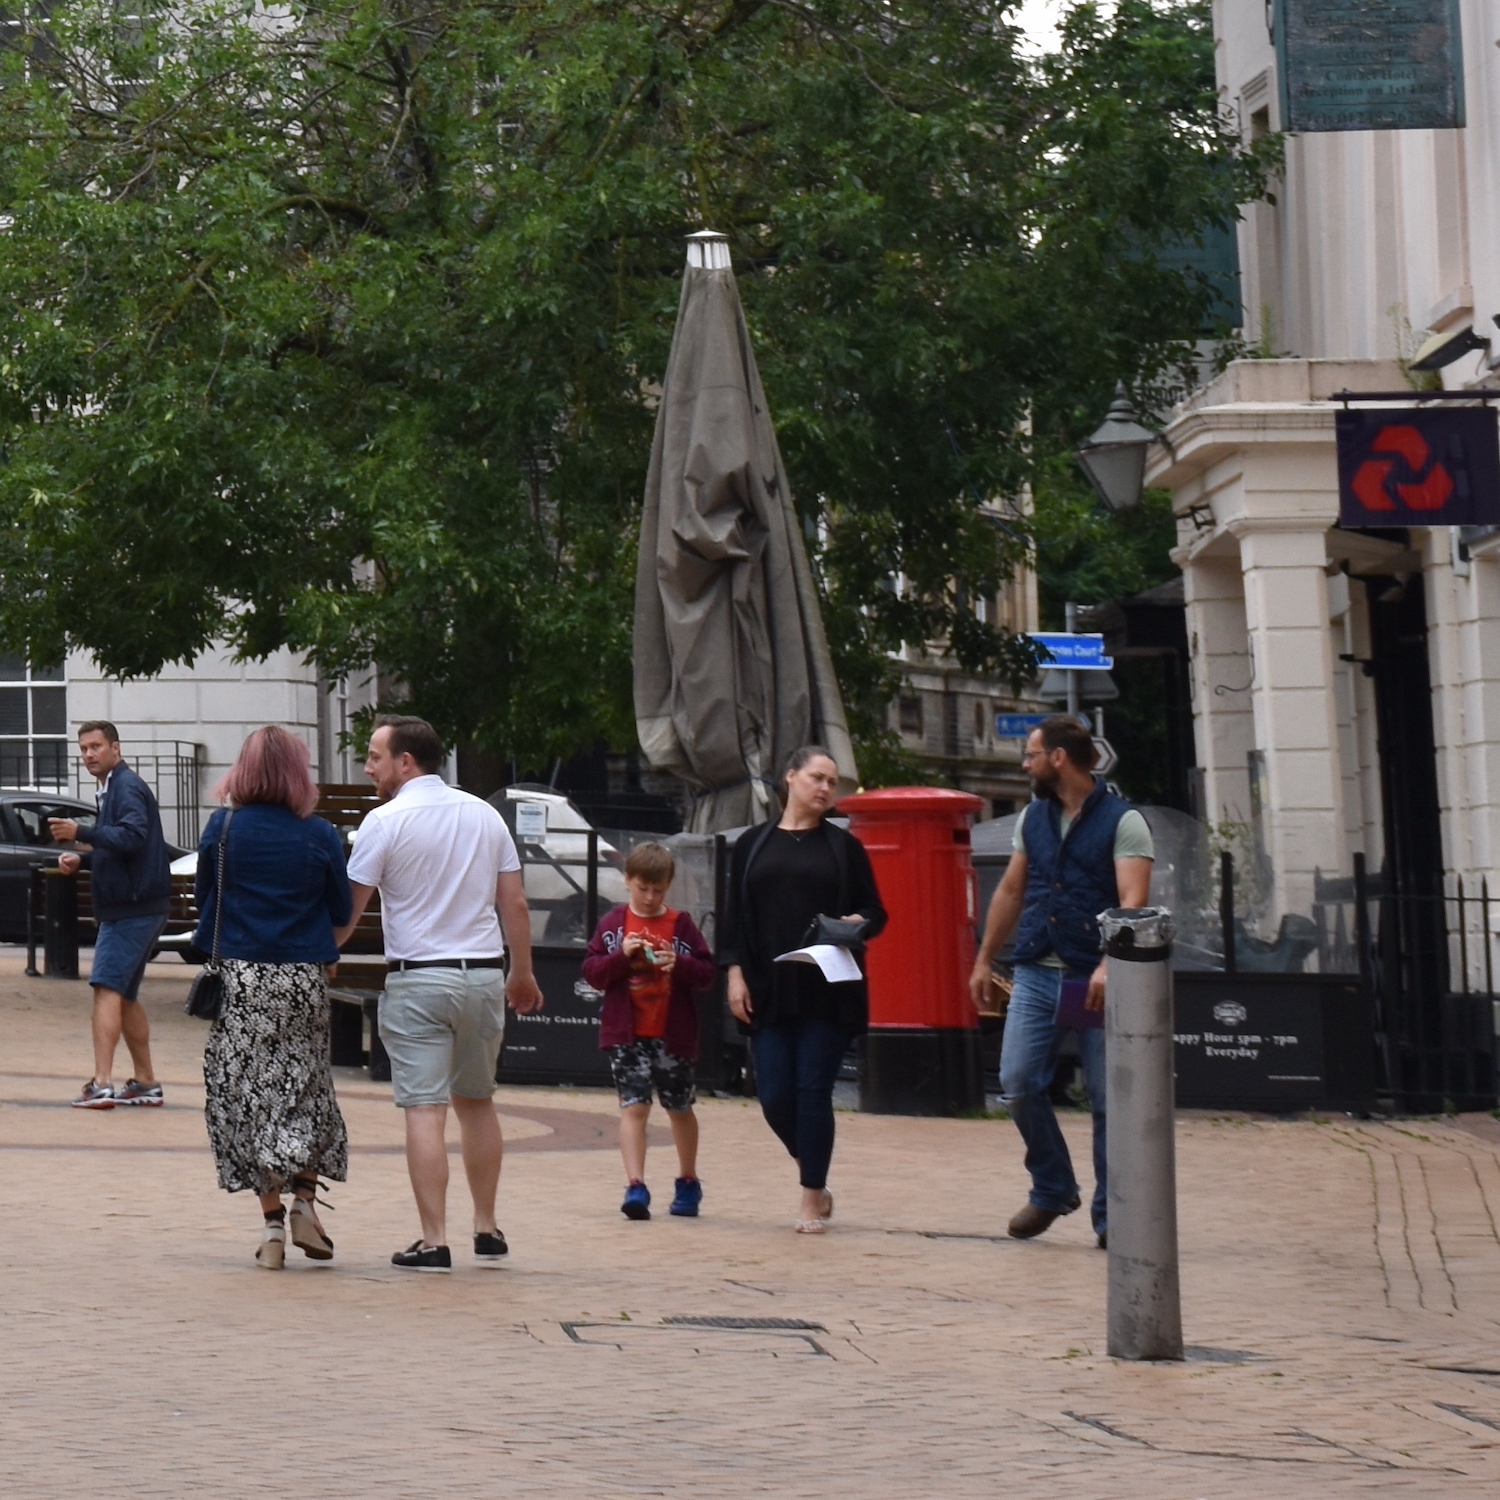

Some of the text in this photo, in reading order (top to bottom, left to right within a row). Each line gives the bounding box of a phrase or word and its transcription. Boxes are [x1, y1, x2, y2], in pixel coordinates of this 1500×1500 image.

[517, 1014, 550, 1024] Freshly
[553, 1015, 588, 1024] Cooked
[1172, 1033, 1200, 1045] appy
[1203, 1032, 1234, 1043] Hour
[1205, 1046, 1259, 1060] Everyday
